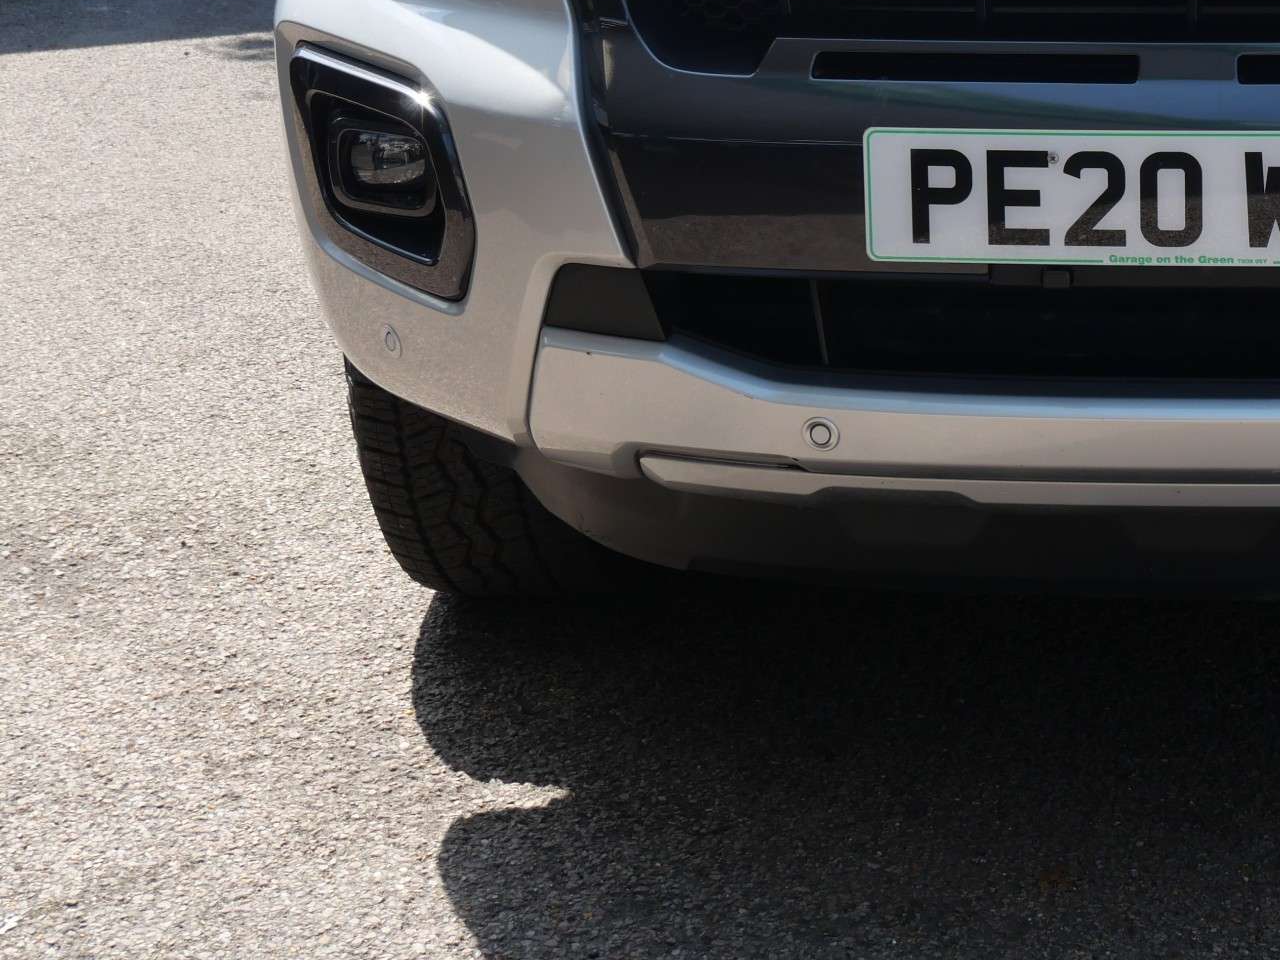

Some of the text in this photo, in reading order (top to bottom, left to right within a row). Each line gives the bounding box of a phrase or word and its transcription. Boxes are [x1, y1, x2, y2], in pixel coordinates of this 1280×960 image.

[910, 148, 1203, 248] PE20
[1109, 255, 1152, 265] Garage
[1174, 255, 1194, 264] the
[1198, 255, 1234, 264] Green
